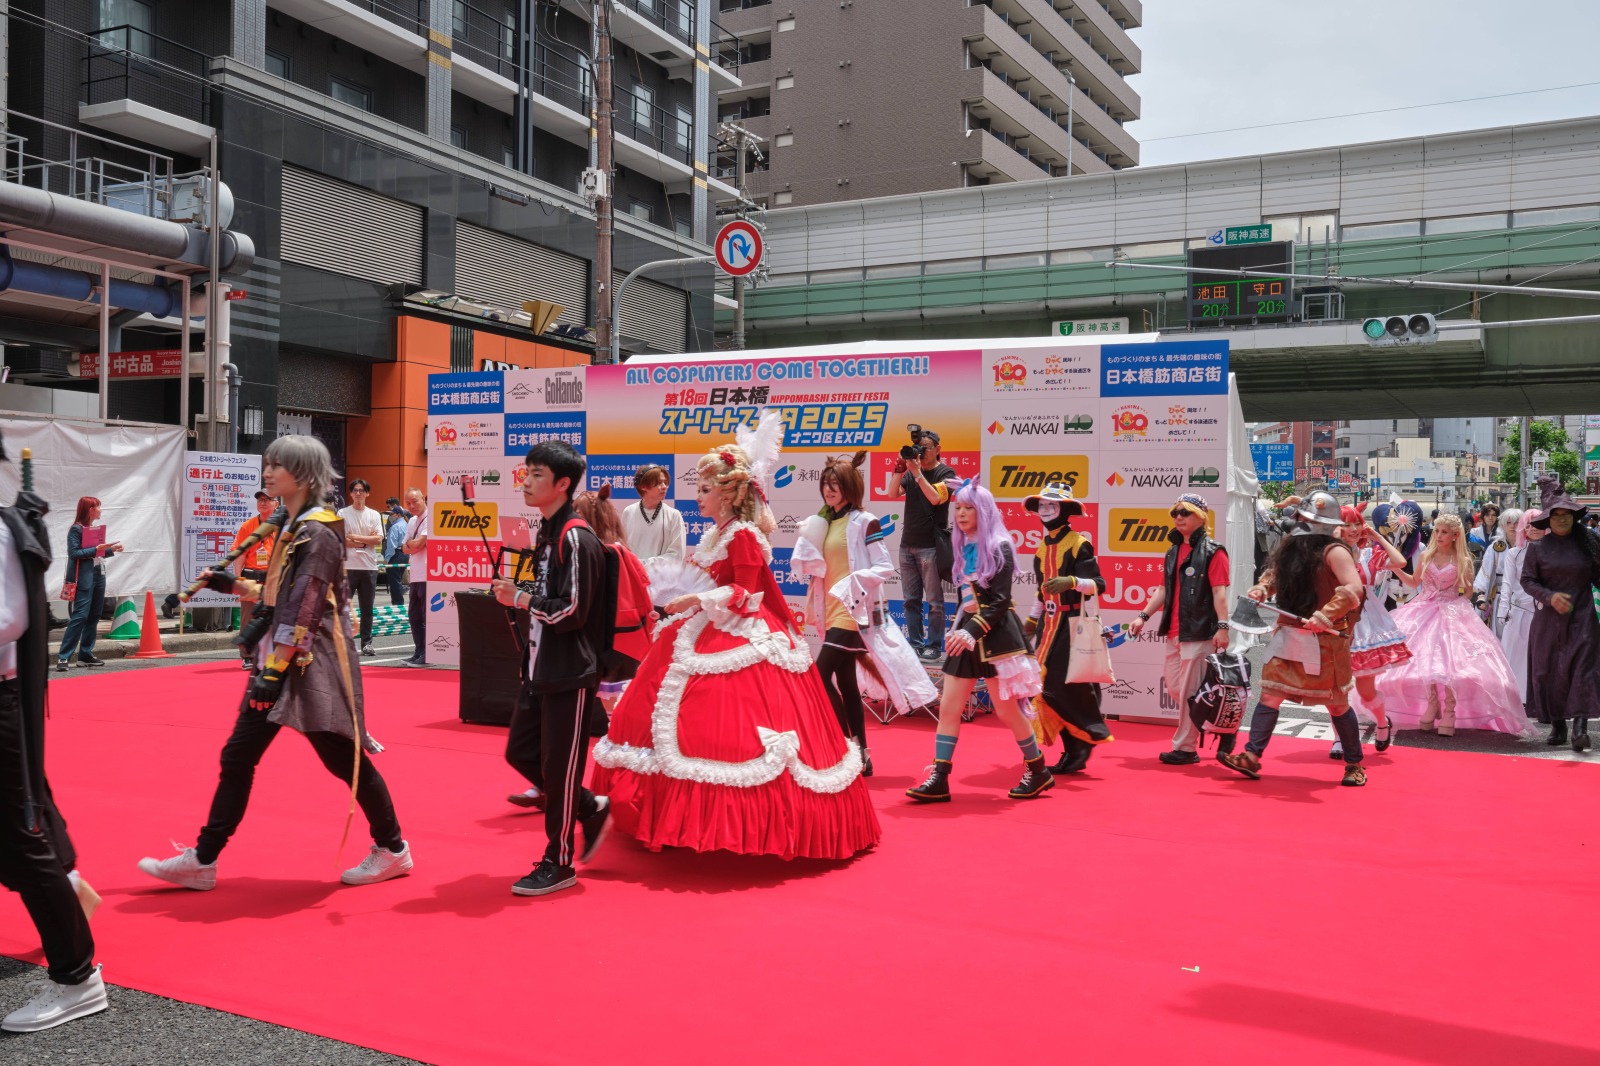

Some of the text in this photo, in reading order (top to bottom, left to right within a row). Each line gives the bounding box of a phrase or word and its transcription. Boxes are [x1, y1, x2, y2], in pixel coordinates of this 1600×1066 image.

[1228, 229, 1270, 241] 阪神高速
[1197, 285, 1226, 300] 池田
[1253, 282, 1282, 297] 守口
[1202, 303, 1230, 317] 20分
[1257, 300, 1286, 315] 20分
[1076, 321, 1121, 333] 阪神高速
[113, 355, 153, 373] 中古品
[1107, 355, 1158, 363] ものづくりのまち
[626, 357, 930, 385] ALL COSPLAYERS COME TOGETHER!!
[1106, 366, 1222, 385] 日本橋筋商店街
[545, 376, 583, 405] GoHands
[664, 386, 770, 406] 第18回 日本橋
[770, 391, 890, 404] NIPPOMBASHI STREET FESTA
[431, 391, 501, 406] 日本橋筋商店街
[1010, 422, 1059, 435] NANKAI
[446, 475, 479, 486] NAAI
[999, 465, 1079, 488] Times
[1131, 475, 1184, 488] NANKAI
[439, 510, 492, 529] Times
[1118, 518, 1169, 542] Tim
